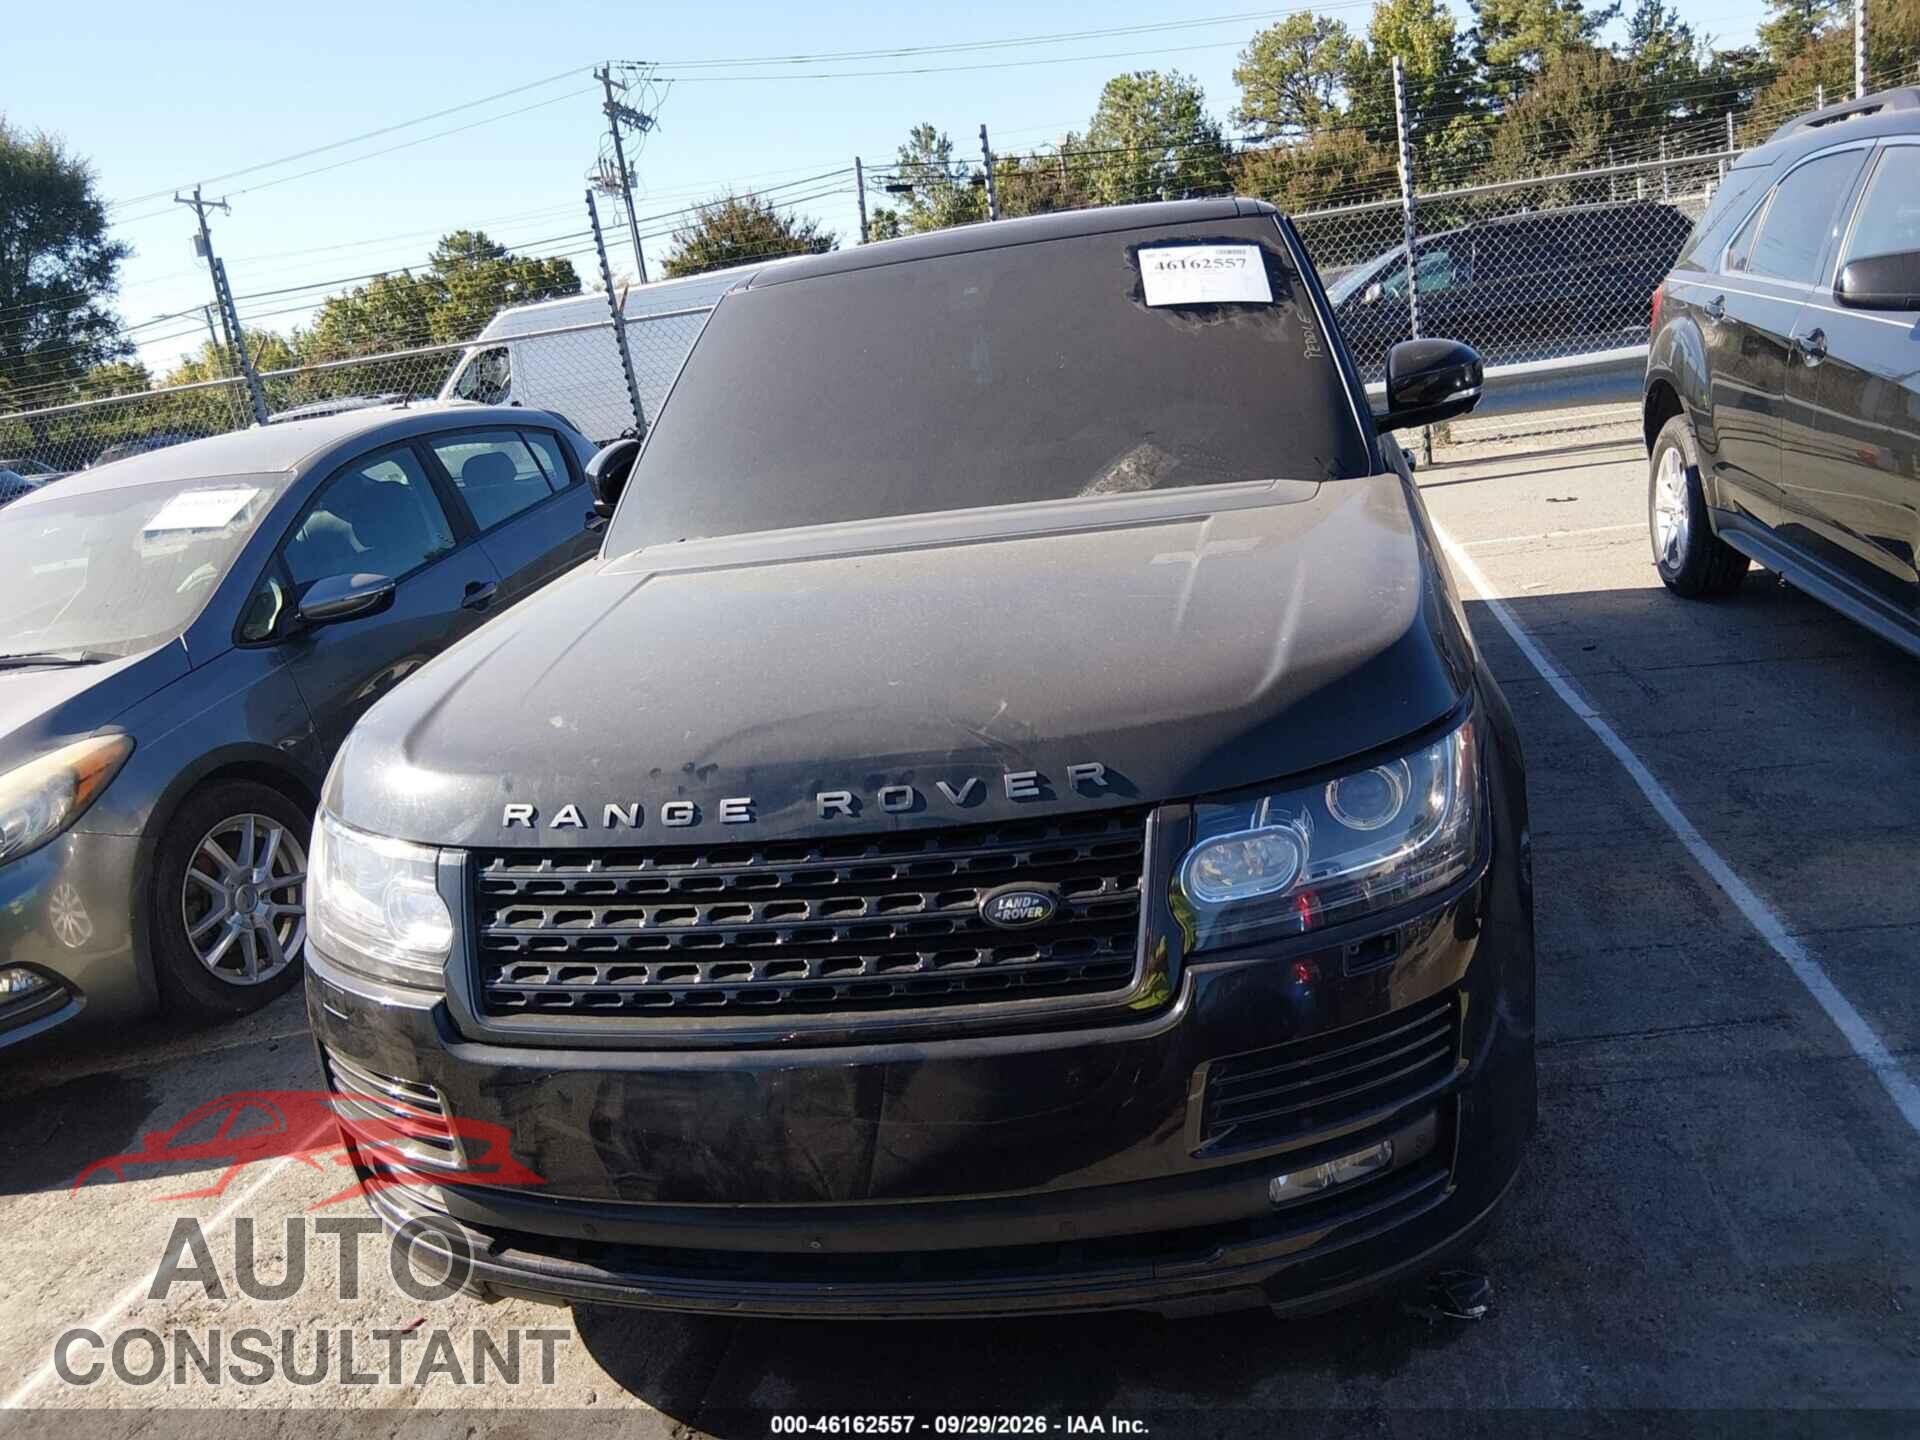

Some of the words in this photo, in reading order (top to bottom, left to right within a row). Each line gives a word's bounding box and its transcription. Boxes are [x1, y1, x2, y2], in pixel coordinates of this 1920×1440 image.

[1154, 257, 1247, 271] 46162557
[502, 797, 752, 829] RANGE
[816, 761, 1109, 818] ROVER
[998, 896, 1031, 910] LAND
[1002, 906, 1044, 921] ROVER
